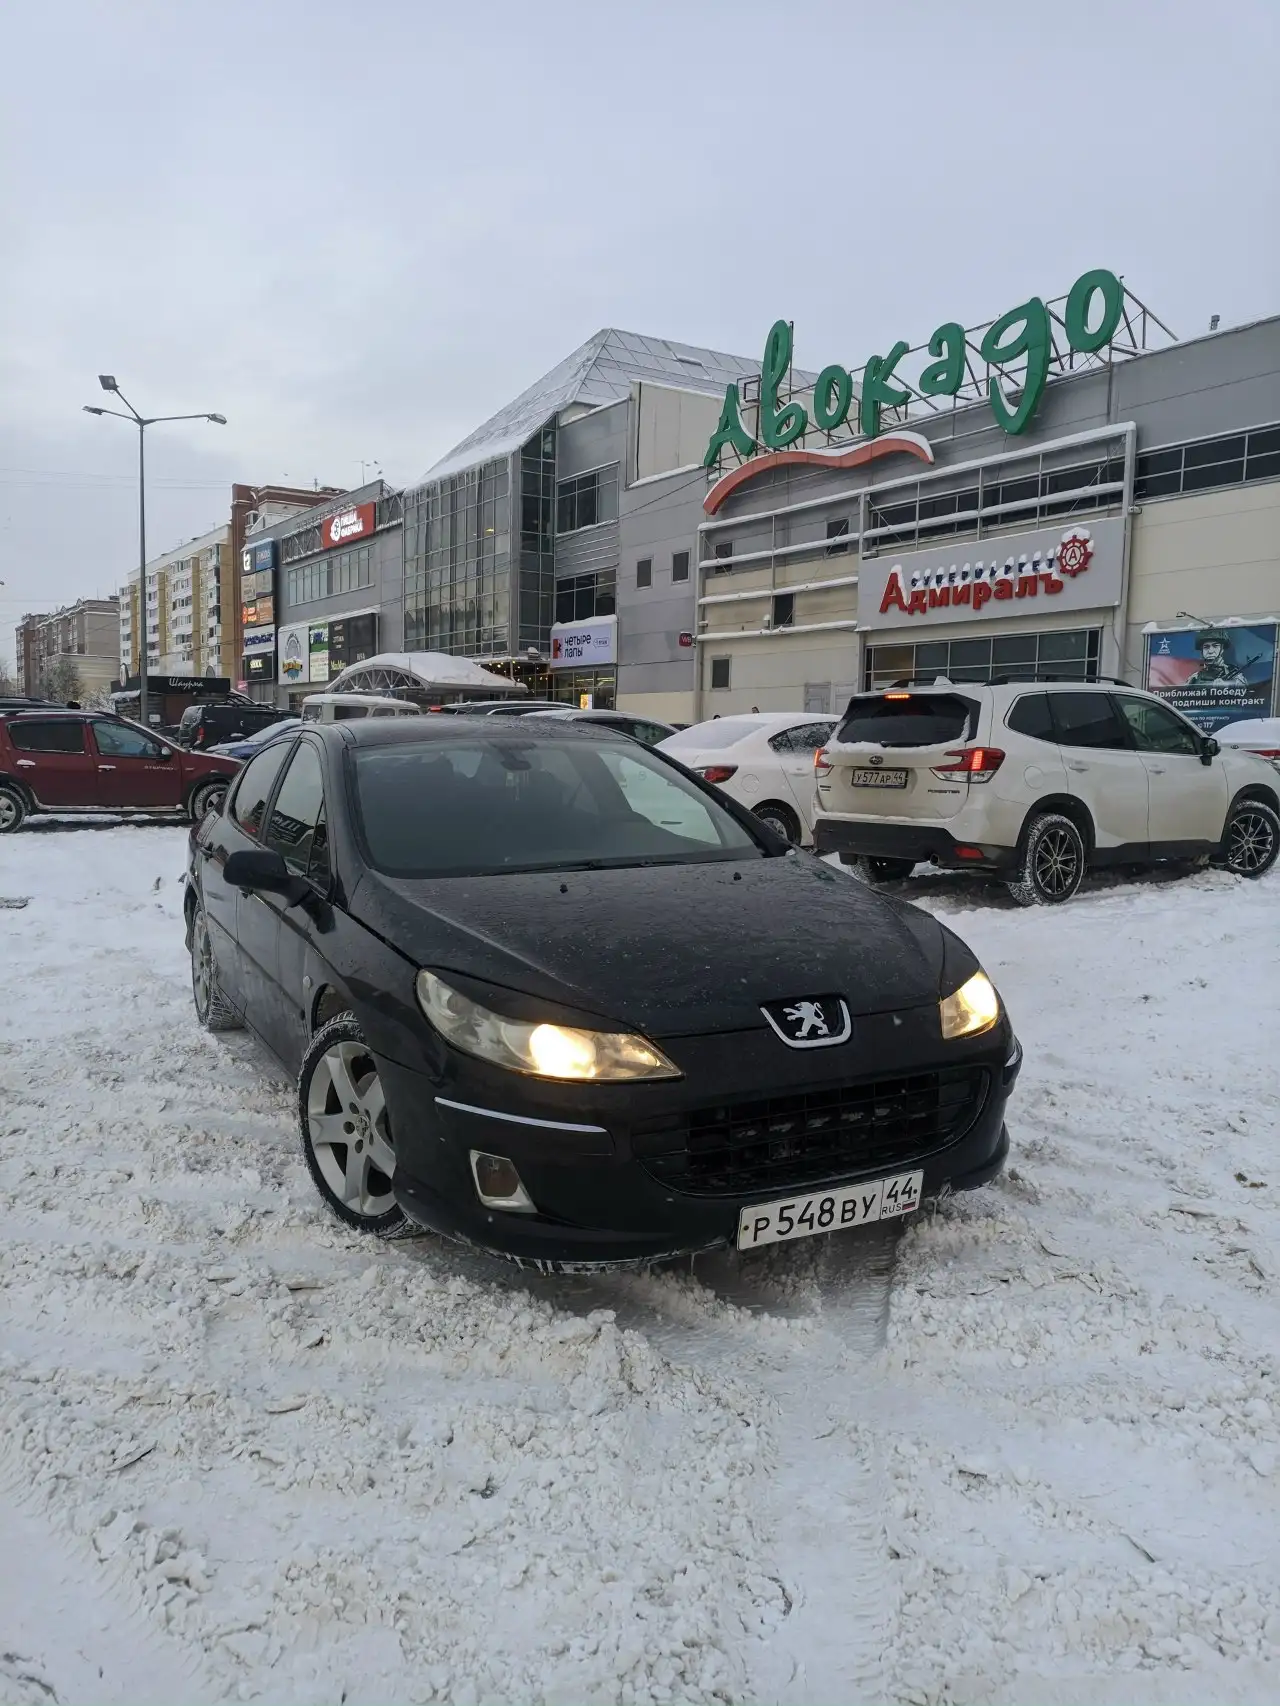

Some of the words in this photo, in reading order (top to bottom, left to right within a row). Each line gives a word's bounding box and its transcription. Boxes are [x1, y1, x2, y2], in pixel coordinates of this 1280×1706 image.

[703, 268, 1124, 467] Авокадо
[880, 568, 1064, 615] Адмиралъ
[564, 647, 583, 658] лапы
[168, 677, 204, 690] Шаурма
[1153, 688, 1207, 698] Приближай
[1210, 687, 1247, 696] Победу
[1219, 698, 1265, 706] контракт
[886, 1176, 913, 1203] 44
[881, 1202, 902, 1215] RUS
